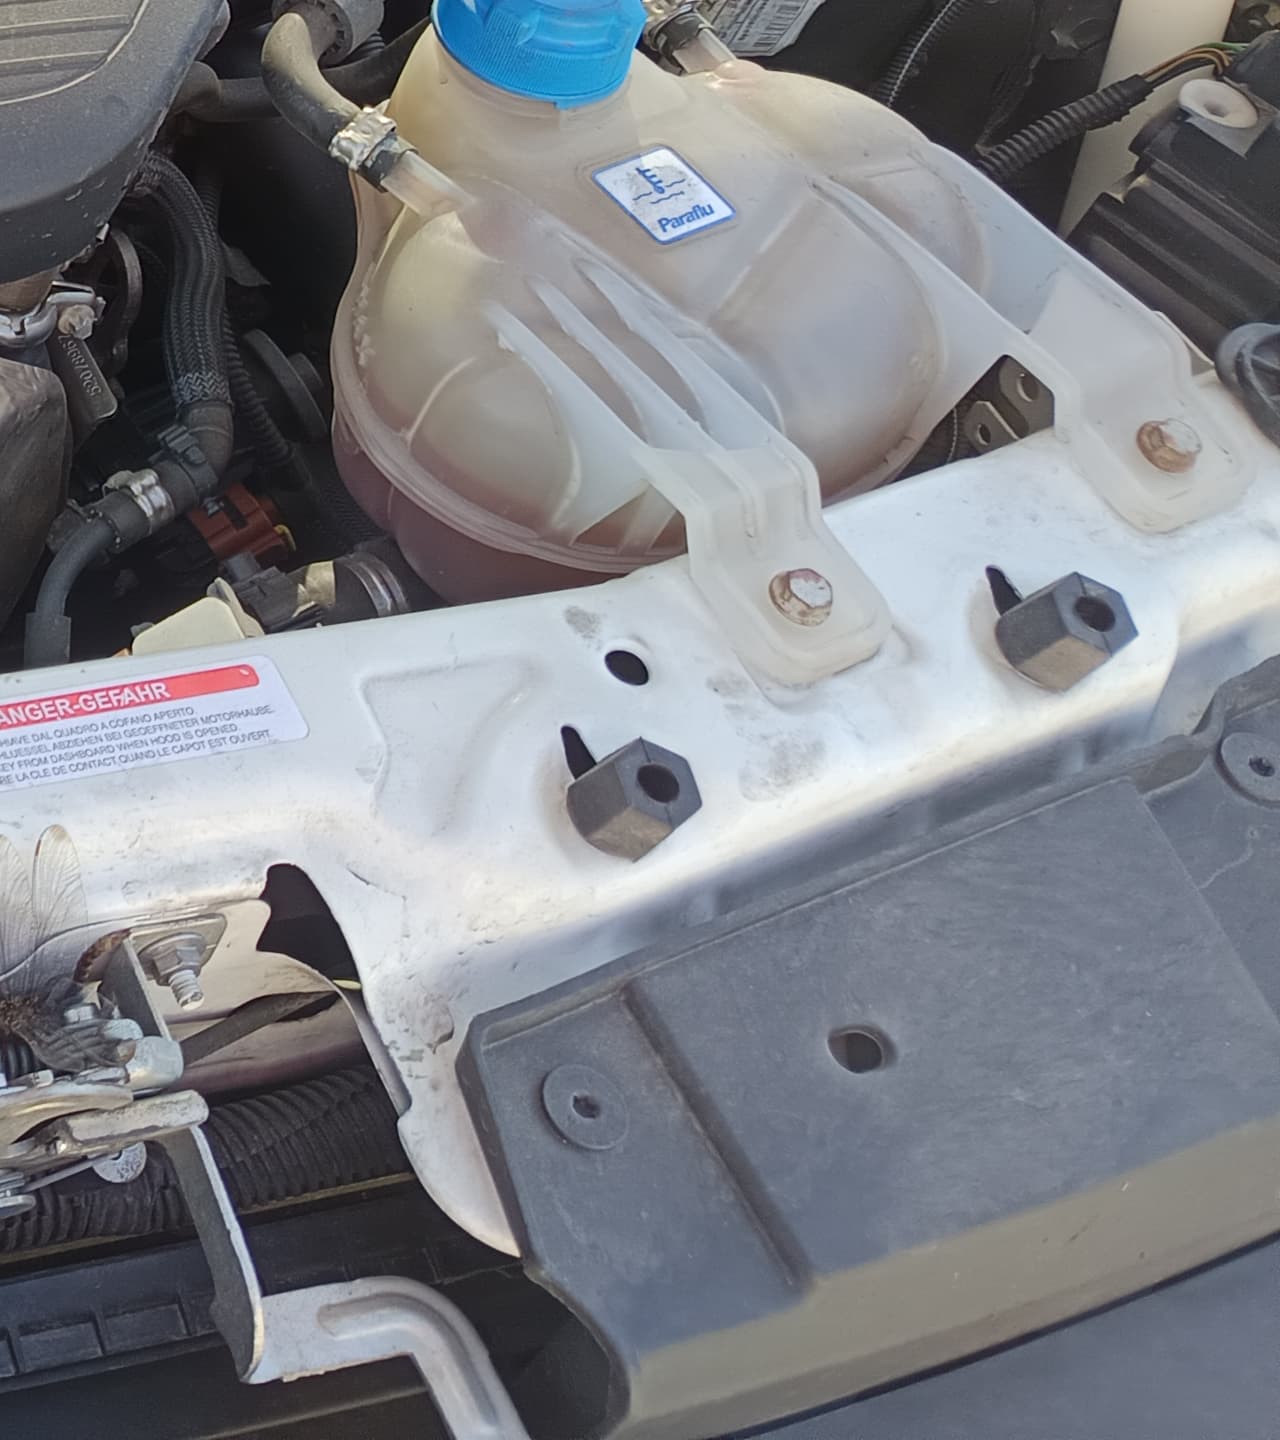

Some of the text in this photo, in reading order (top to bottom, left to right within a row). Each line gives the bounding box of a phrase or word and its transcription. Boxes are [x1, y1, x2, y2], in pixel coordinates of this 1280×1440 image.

[657, 203, 714, 232] Paraflu
[31, 730, 53, 742] DAL
[53, 722, 99, 738] QUADRO
[99, 721, 108, 731] A
[108, 713, 152, 729] COFANO
[15, 772, 28, 782] LA
[29, 768, 49, 780] CLE
[52, 765, 68, 776] DE
[68, 757, 117, 773] CONTACT
[118, 750, 157, 765] QUAND
[157, 748, 171, 758] LE
[171, 742, 206, 756] CAPOT
[207, 738, 229, 750] EST
[17, 756, 48, 769] FROM
[49, 744, 115, 764] DASHBOARD
[116, 739, 149, 752] WHEN
[150, 733, 181, 747] HOOD
[183, 731, 194, 741] IS
